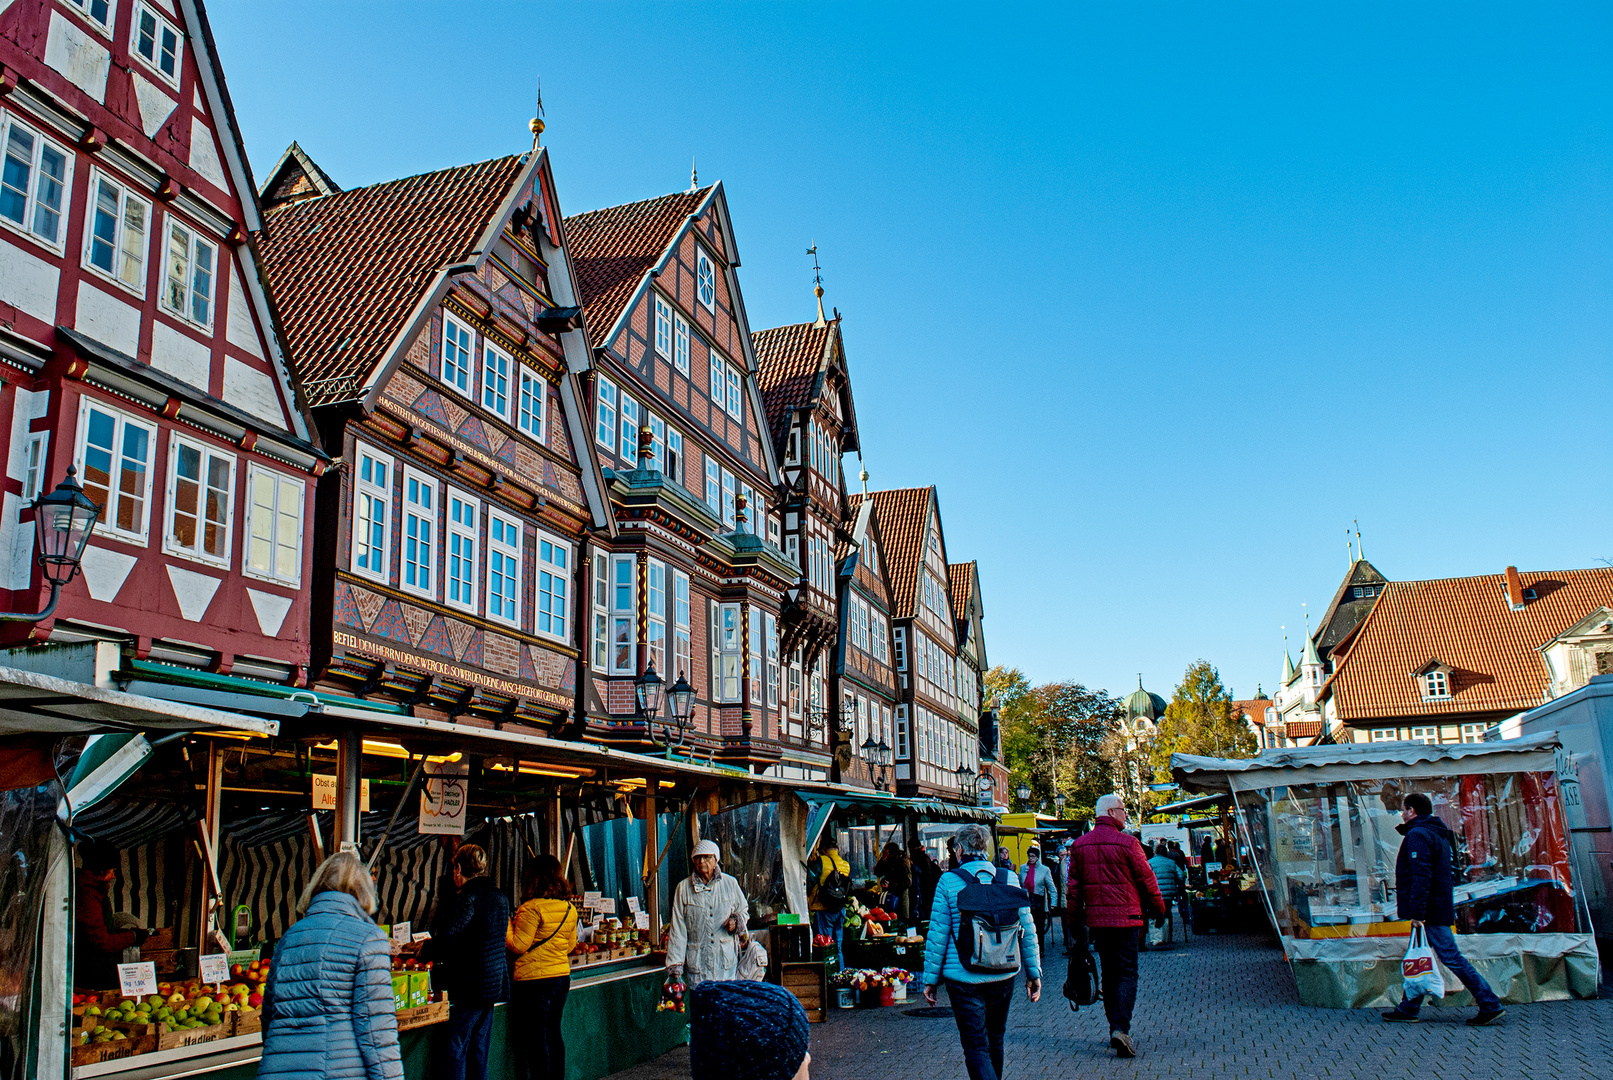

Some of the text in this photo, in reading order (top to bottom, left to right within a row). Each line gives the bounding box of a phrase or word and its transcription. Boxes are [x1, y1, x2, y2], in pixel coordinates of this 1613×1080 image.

[393, 403, 410, 420] STEHT
[358, 638, 374, 654] DEM
[376, 643, 400, 661] HERRN
[400, 651, 420, 667] DEINE
[450, 665, 459, 678] SO
[460, 668, 483, 684] WERDEN
[315, 778, 330, 788] Obst
[321, 794, 336, 805] Alte
[184, 1034, 217, 1047] Hadler
